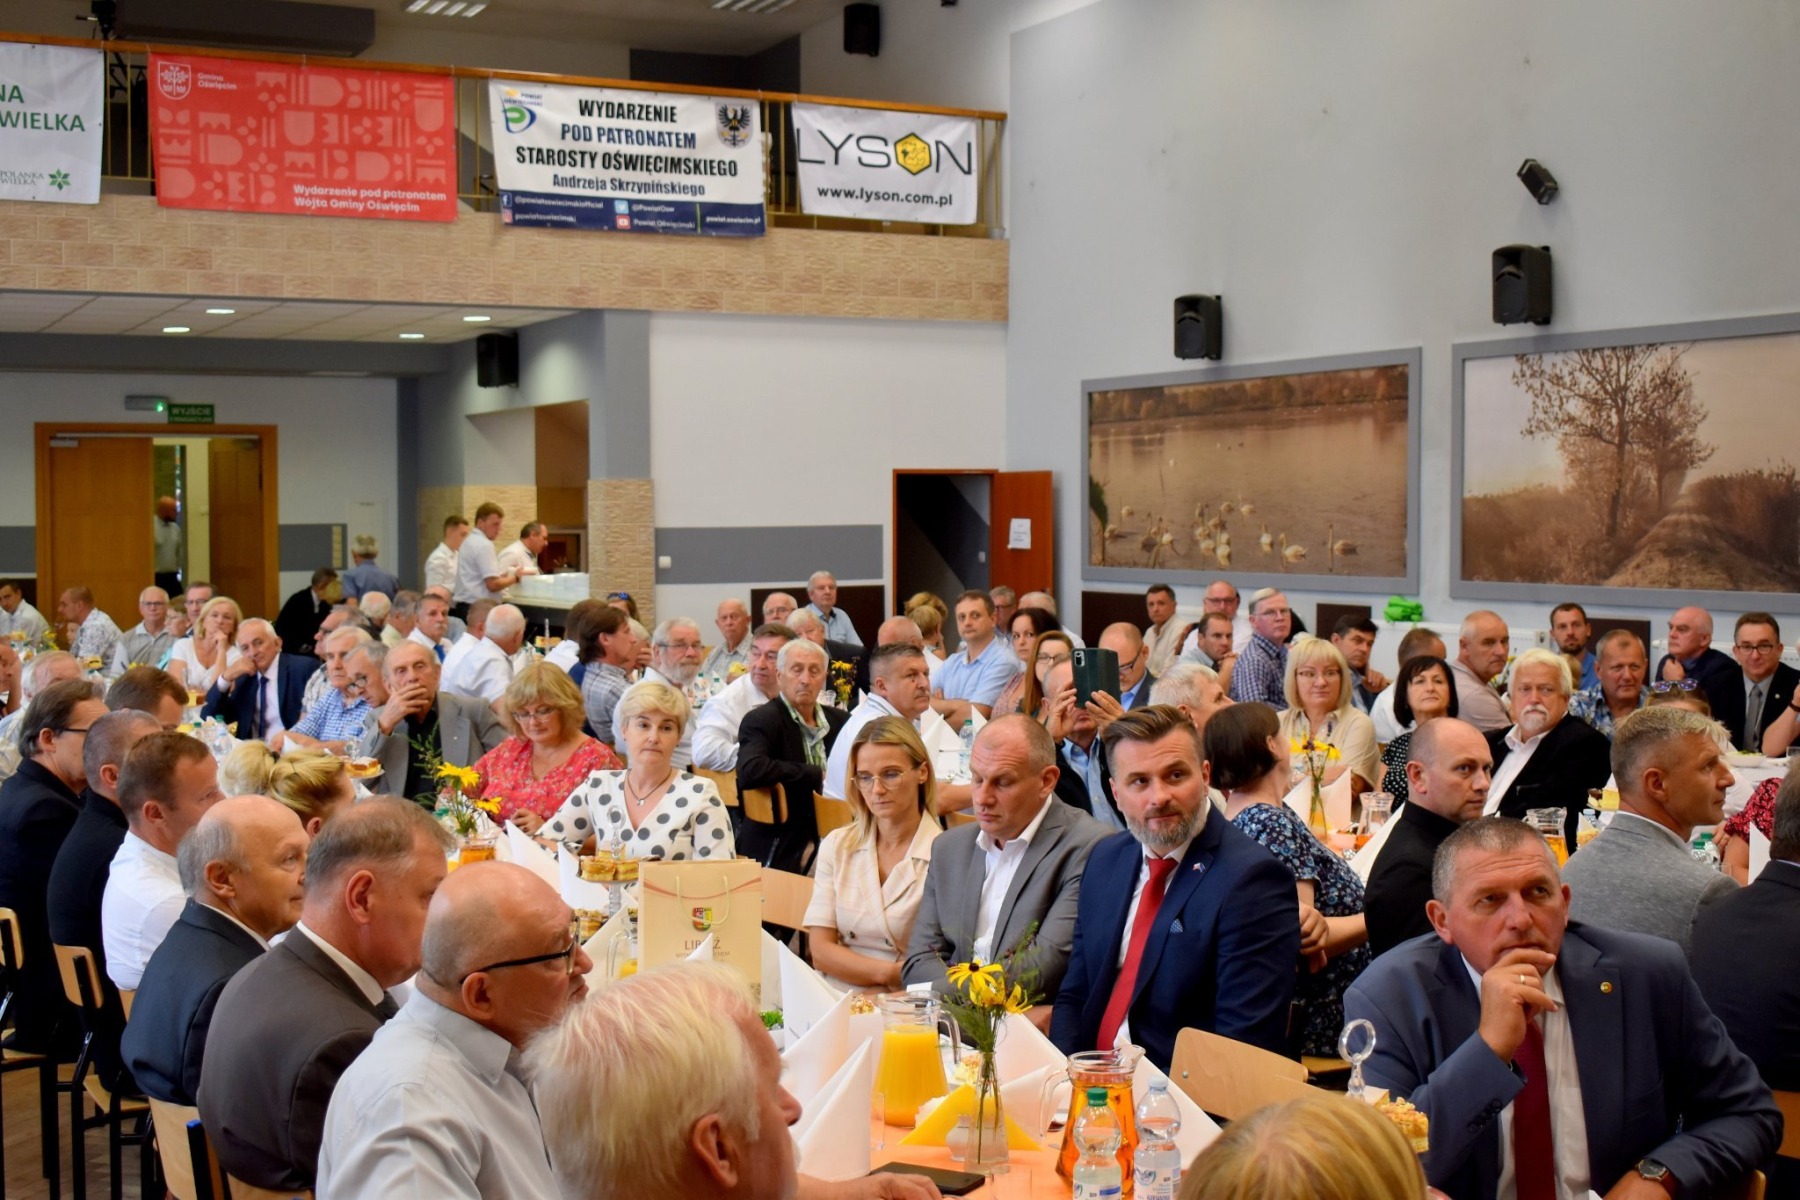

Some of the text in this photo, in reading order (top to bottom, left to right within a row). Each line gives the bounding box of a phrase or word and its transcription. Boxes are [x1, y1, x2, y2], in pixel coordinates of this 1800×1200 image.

[198, 72, 224, 82] Gmina
[0, 110, 85, 132] WIELKA
[579, 98, 678, 123] WYDARZENIE
[560, 123, 697, 150] POD PATRONATEM
[516, 145, 738, 177] STAROSTY OŚWIĘCIMSKIEGO
[796, 127, 972, 176] LYSON
[294, 184, 447, 201] Wydarzenie pod patronatem
[553, 173, 706, 197] Andrzeja Skrzypińskiego
[295, 196, 420, 213] Wójta Gminy Oświęcim
[817, 186, 953, 208] www.lyson.com.pl
